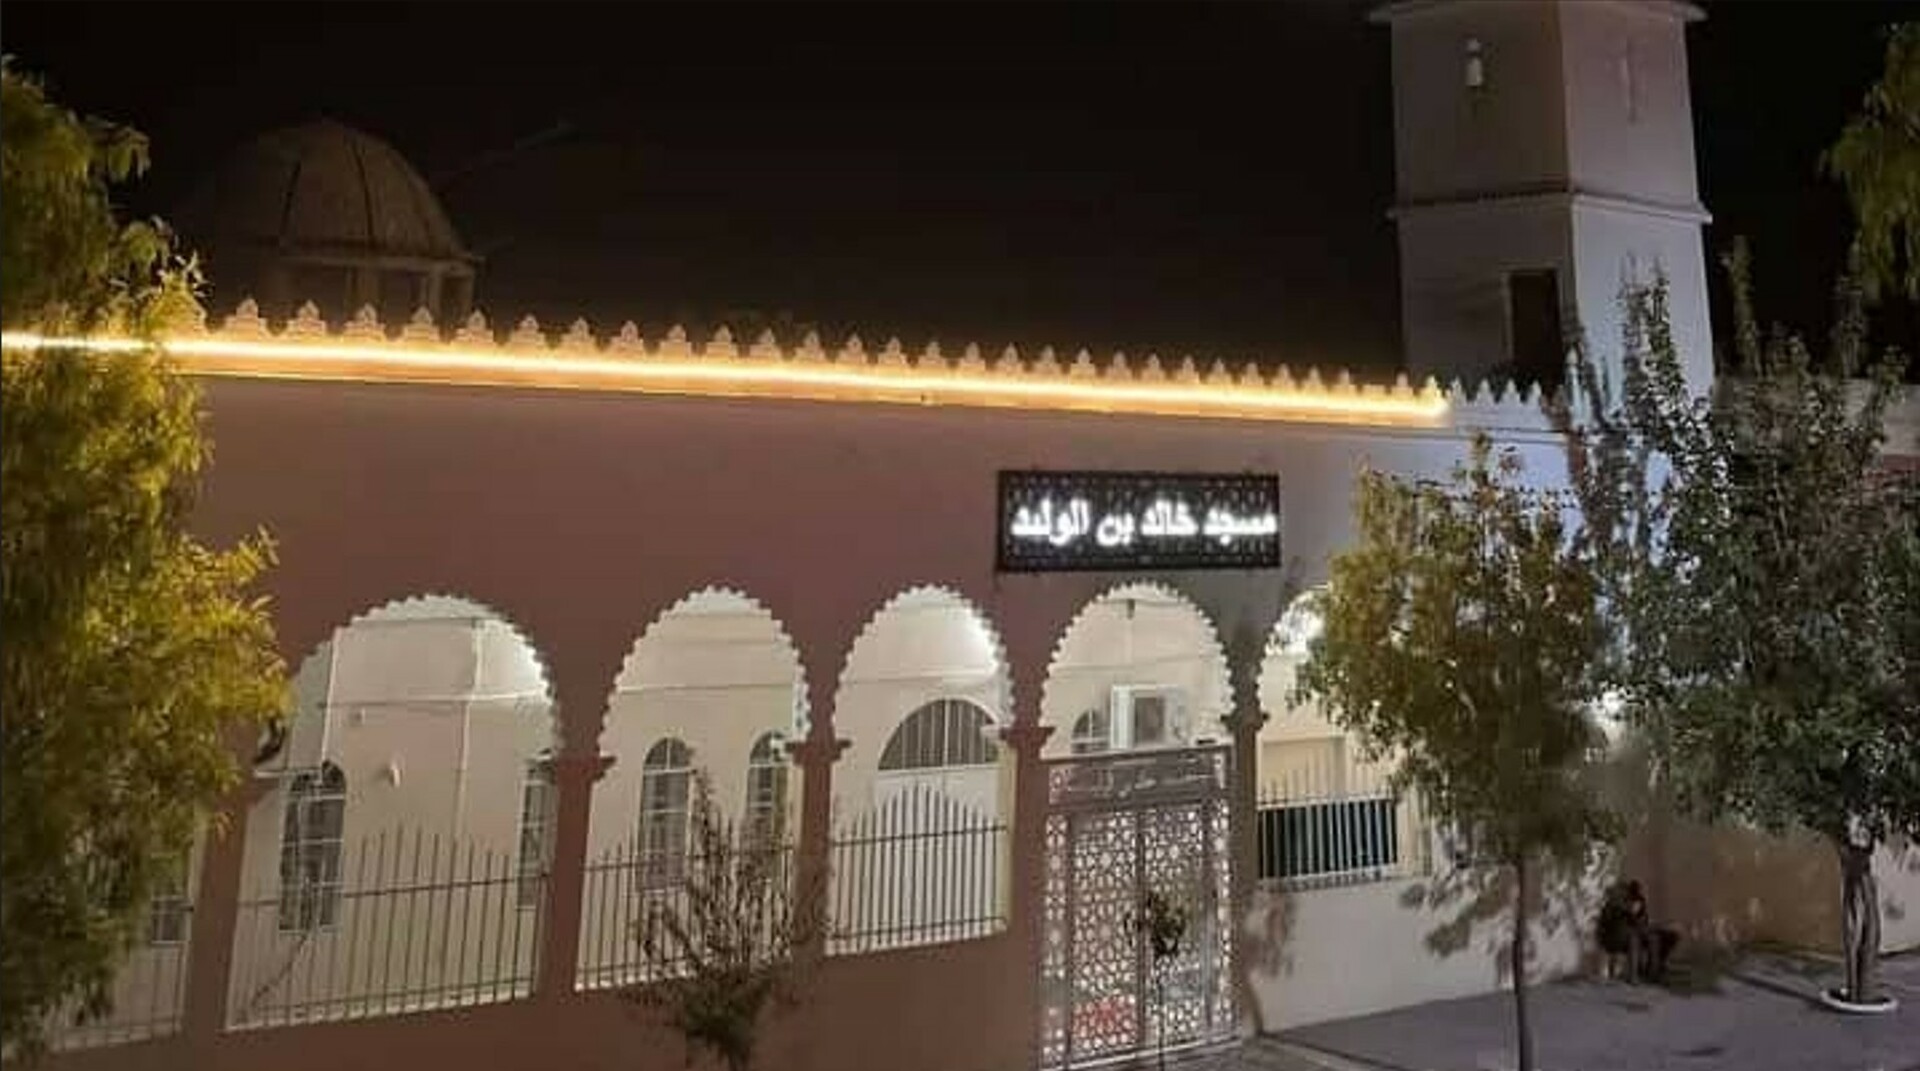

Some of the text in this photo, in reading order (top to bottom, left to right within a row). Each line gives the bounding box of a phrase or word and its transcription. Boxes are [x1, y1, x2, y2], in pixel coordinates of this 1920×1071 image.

[1096, 512, 1135, 547] بن
[1140, 498, 1199, 537] خالد
[1202, 505, 1278, 546] مسجد
